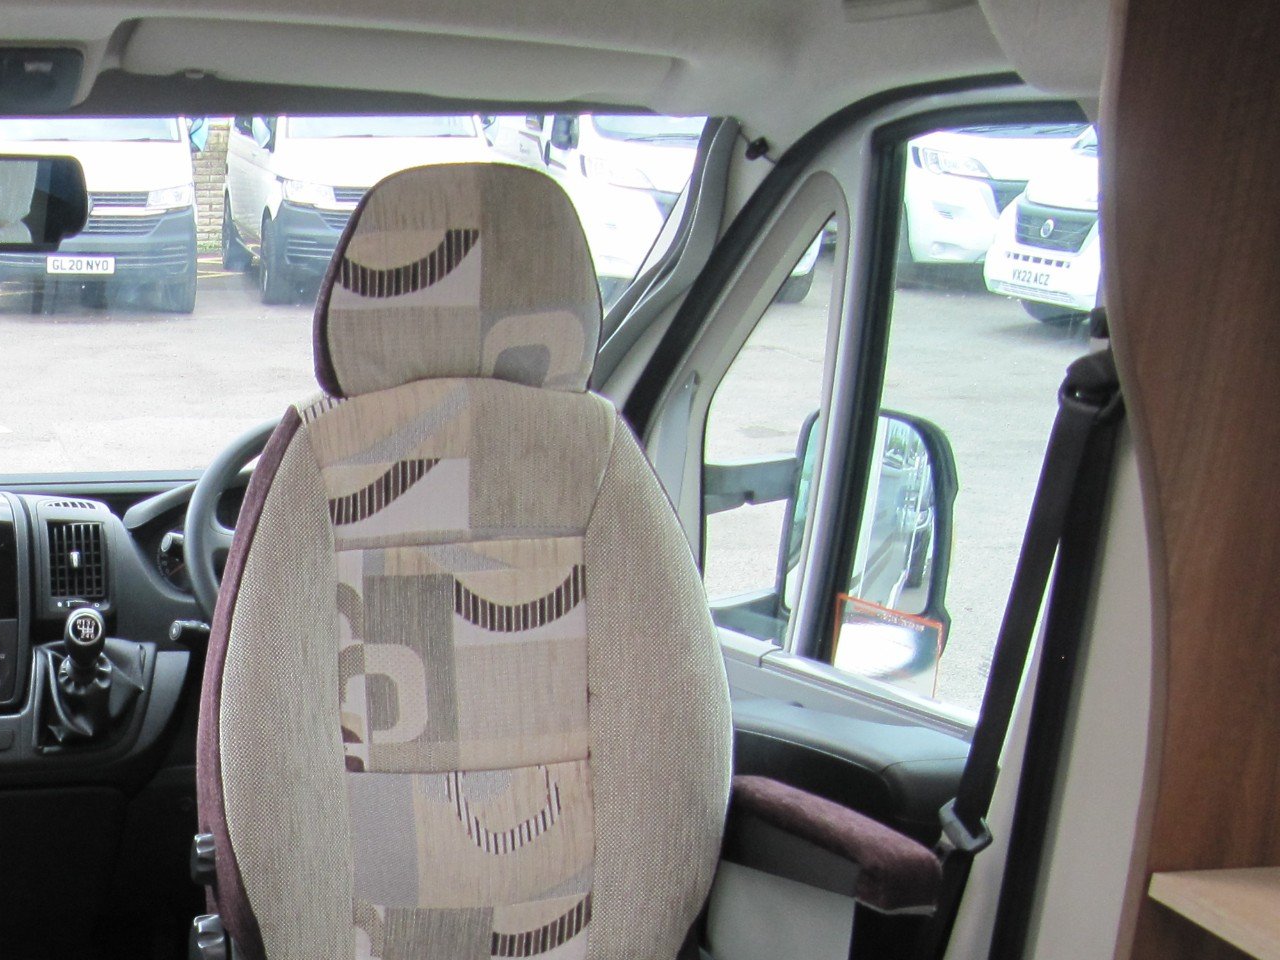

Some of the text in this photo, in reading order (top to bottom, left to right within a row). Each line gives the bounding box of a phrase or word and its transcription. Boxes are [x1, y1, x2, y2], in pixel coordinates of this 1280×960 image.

[52, 259, 83, 271] GL20
[1012, 269, 1050, 286] VX22 ACZ
